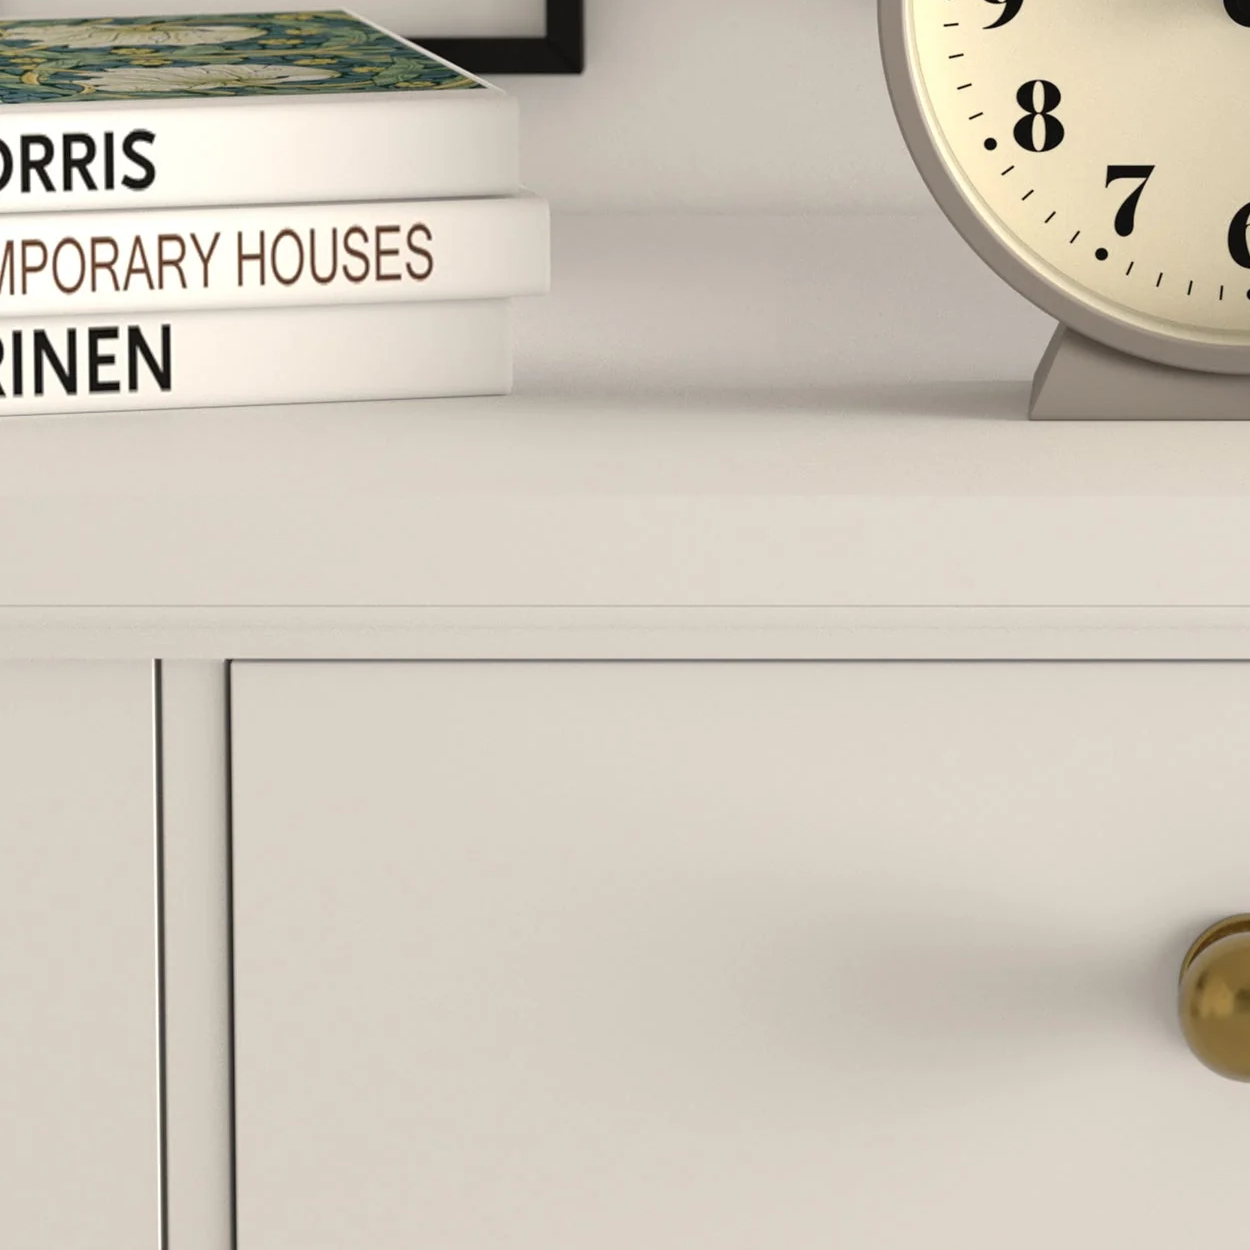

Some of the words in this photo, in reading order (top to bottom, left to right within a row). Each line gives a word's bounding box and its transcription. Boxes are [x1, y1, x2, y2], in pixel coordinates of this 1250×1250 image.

[1013, 79, 1065, 153] 8
[1105, 164, 1156, 238] 7
[237, 223, 434, 287] HOUSES
[0, 324, 172, 397] INEN
